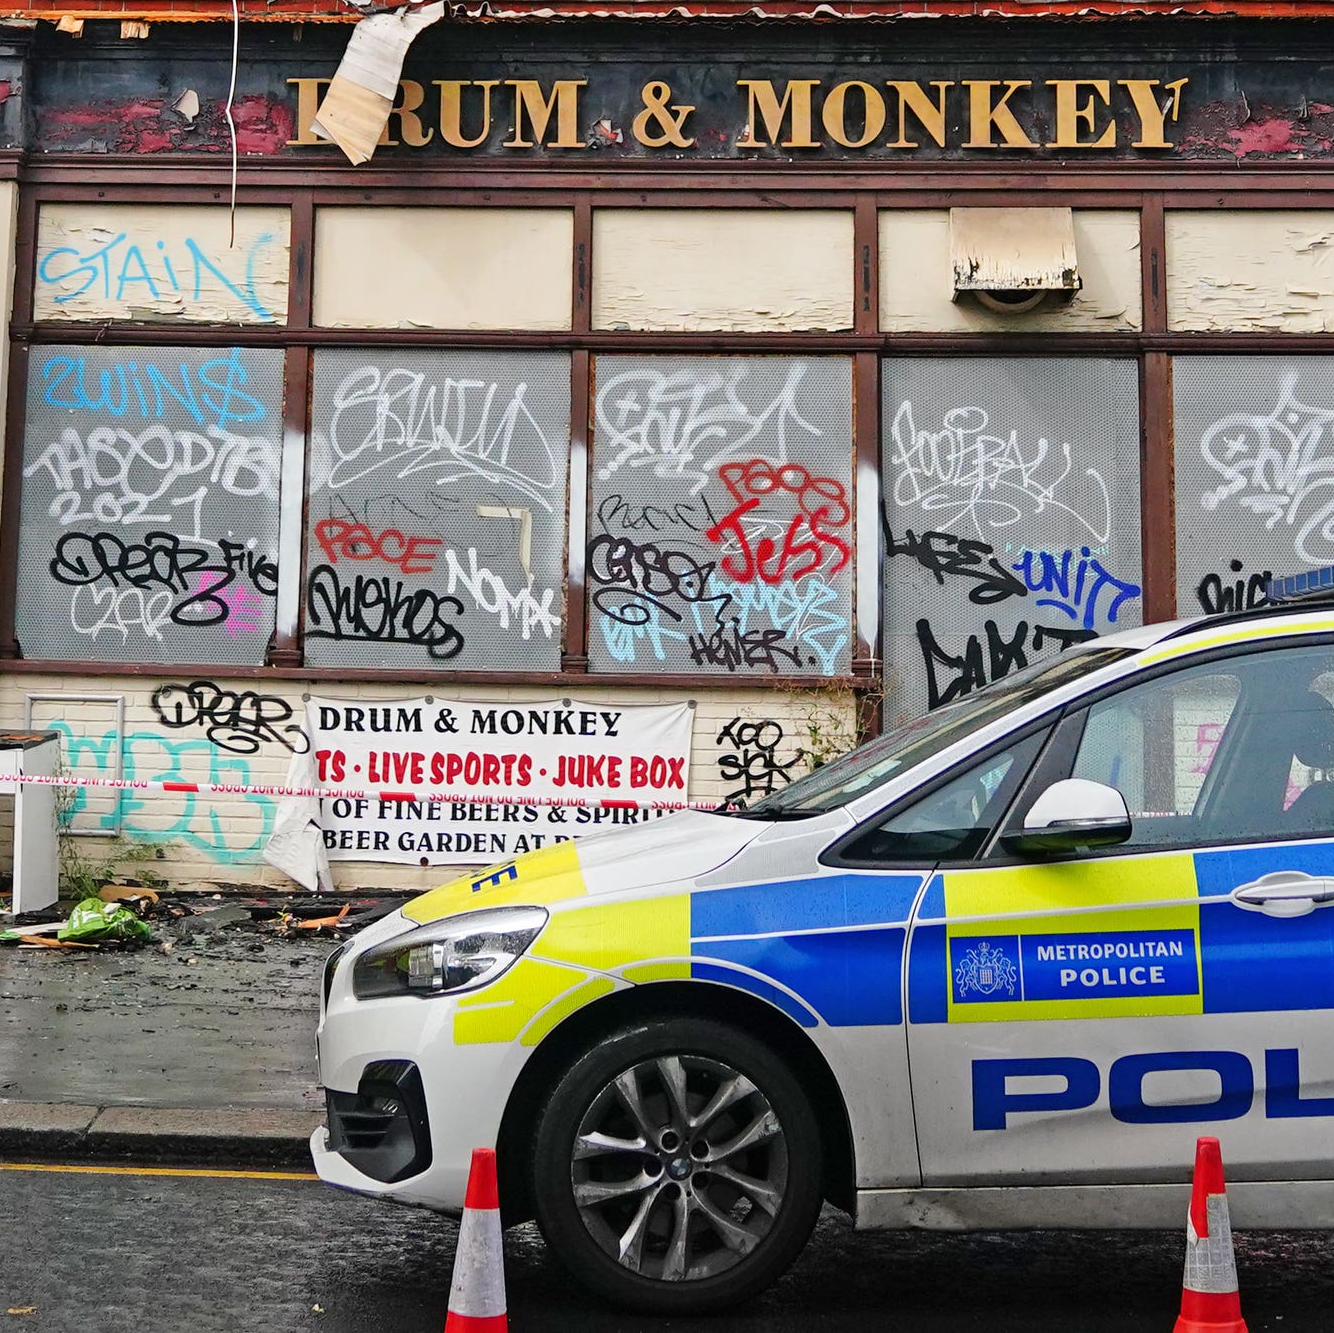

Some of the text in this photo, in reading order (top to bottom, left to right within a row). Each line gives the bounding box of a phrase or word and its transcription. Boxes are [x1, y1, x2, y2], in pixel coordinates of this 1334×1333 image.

[632, 80, 696, 148] &
[736, 77, 1189, 149] MONKEY
[319, 706, 622, 737] DRUM & MONKEY
[368, 751, 425, 784] LIVE
[430, 752, 533, 786] SPORTS
[552, 754, 623, 788] JUKE
[630, 755, 685, 789] BOX
[332, 798, 369, 819] OF
[378, 800, 441, 820] FINE
[450, 802, 538, 823] BEERS
[547, 805, 567, 823] &
[323, 829, 390, 851] BEER
[398, 832, 507, 853] GARDEN
[513, 834, 546, 853] AT
[1037, 941, 1183, 961] METROPOLITAN
[1060, 966, 1165, 987] POLICE
